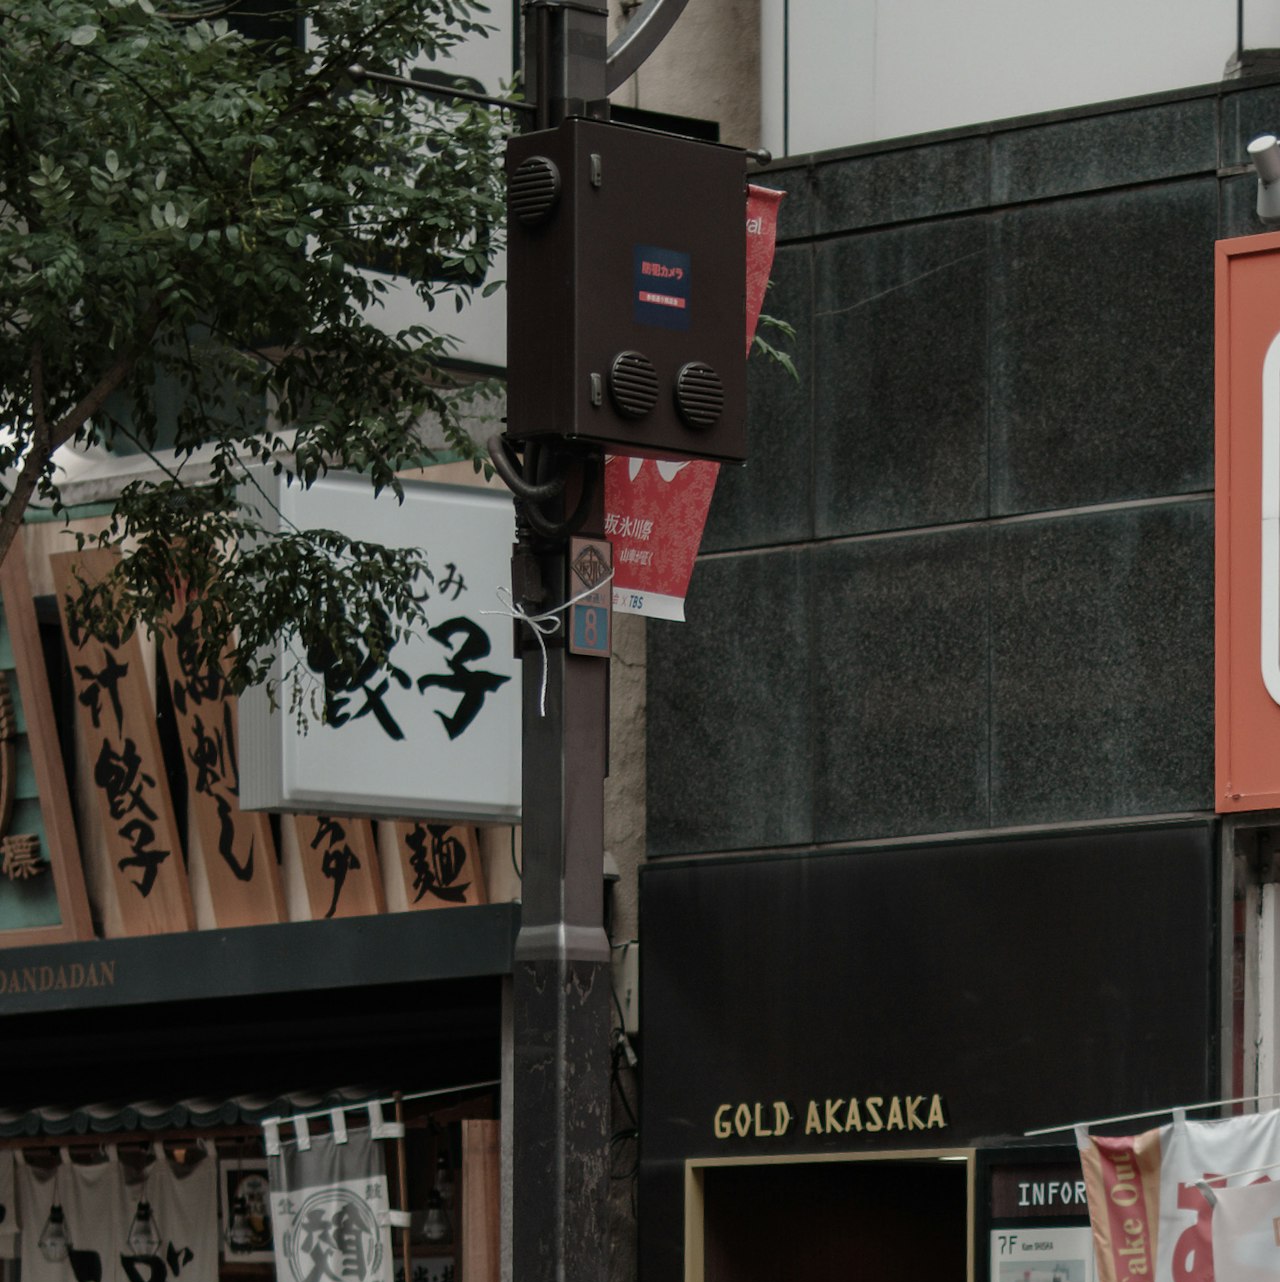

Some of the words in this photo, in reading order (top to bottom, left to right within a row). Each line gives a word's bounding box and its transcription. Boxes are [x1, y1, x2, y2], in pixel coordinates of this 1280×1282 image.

[628, 594, 644, 610] TBS
[585, 608, 598, 646] 8
[714, 1102, 791, 1139] GOLD
[806, 1094, 946, 1135] AKASAKA
[1110, 1151, 1138, 1208] Out
[998, 1235, 1018, 1256] 7F
